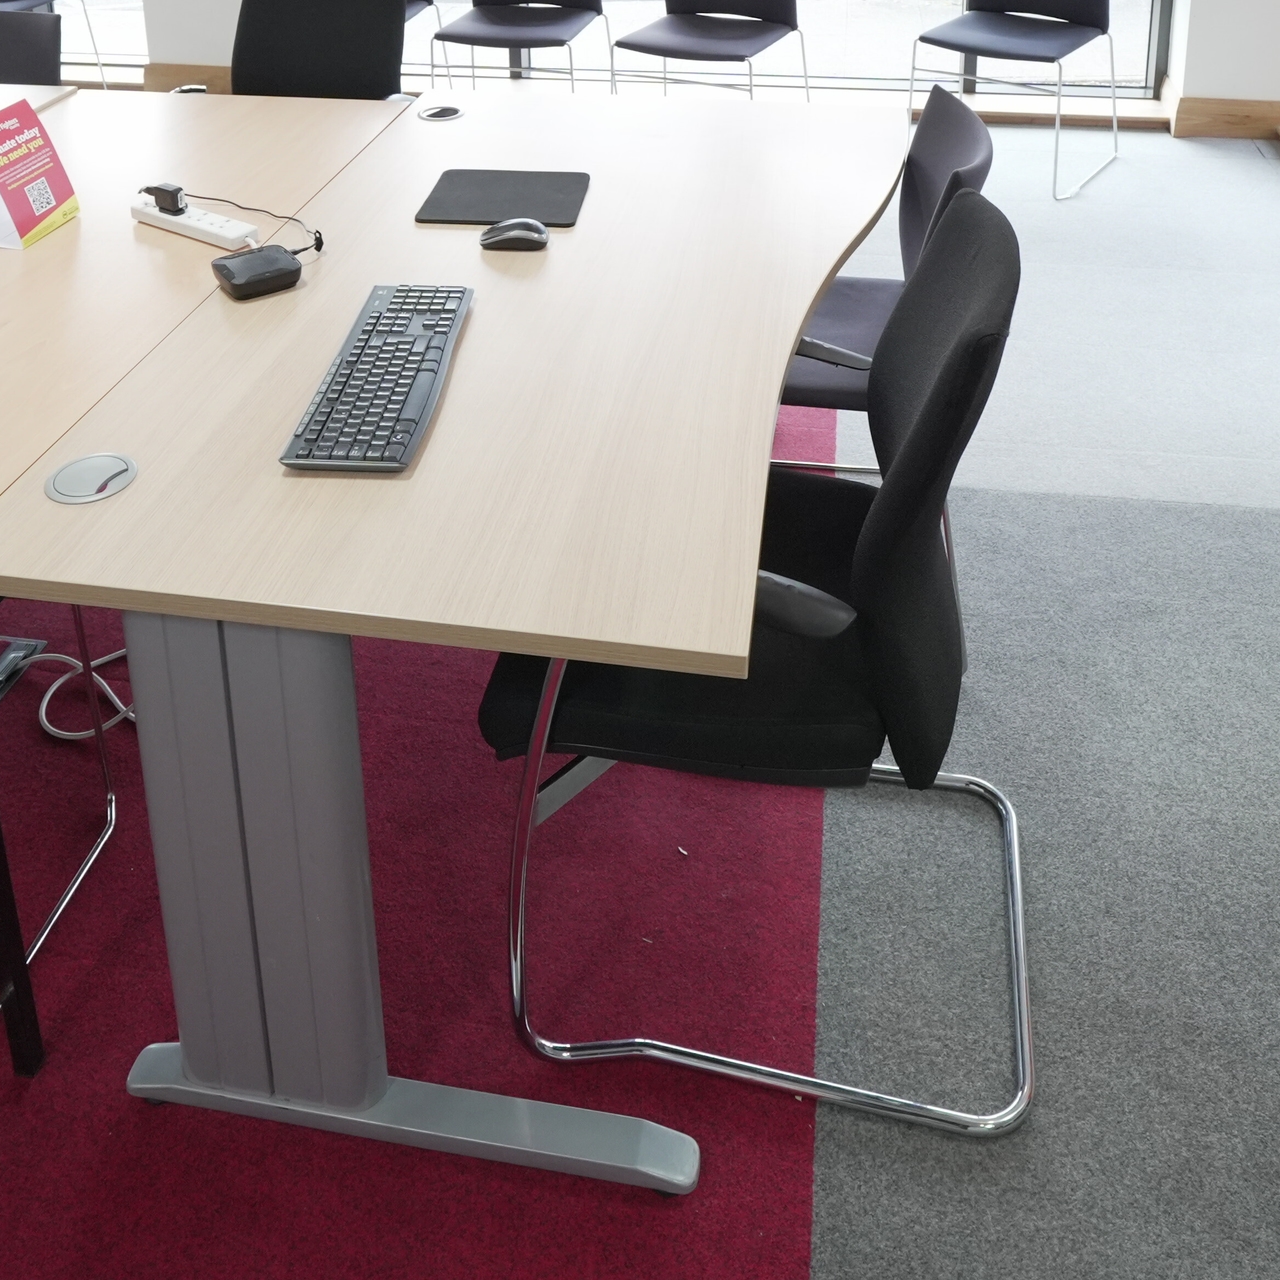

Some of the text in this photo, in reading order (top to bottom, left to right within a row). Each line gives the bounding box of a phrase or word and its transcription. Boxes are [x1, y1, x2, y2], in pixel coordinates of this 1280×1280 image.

[15, 126, 41, 144] today
[7, 143, 29, 161] need
[27, 137, 45, 152] you
